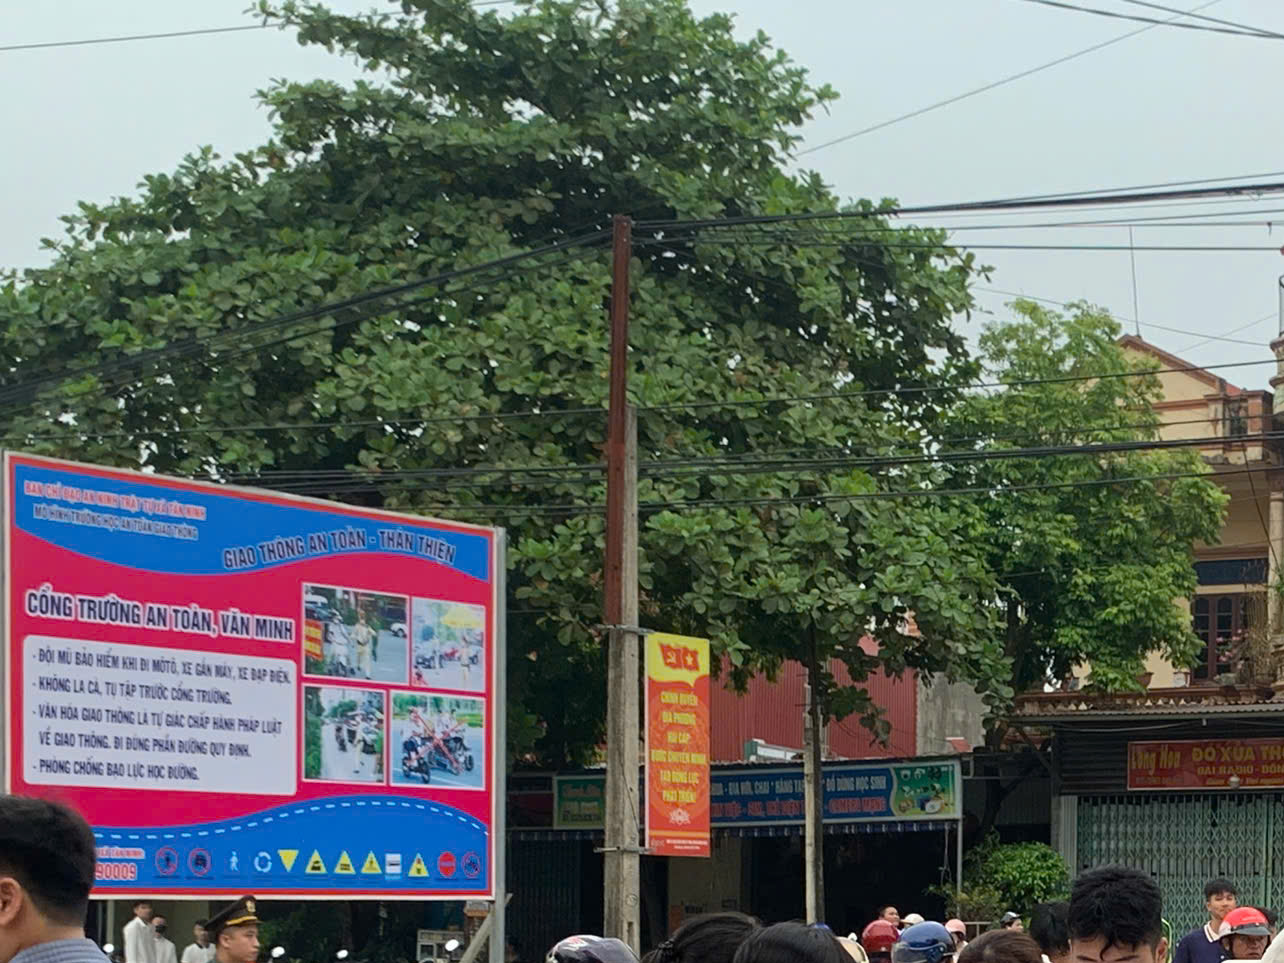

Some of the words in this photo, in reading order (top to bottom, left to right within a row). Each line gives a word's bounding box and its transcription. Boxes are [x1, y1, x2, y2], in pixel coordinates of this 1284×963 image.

[223, 546, 258, 569] GIAO
[258, 536, 305, 565] THÔNG
[307, 532, 328, 554] AN
[330, 525, 367, 550] TOÀN
[377, 526, 414, 552] THÂN
[416, 534, 457, 565] THIỆN
[26, 582, 74, 619] CỔNG
[76, 593, 142, 627] TRƯỜNG
[145, 603, 169, 630] AN
[171, 602, 218, 638] TOÀN,
[219, 607, 251, 638] VĂN
[253, 615, 296, 643] MINH
[39, 645, 55, 666] ĐỘI
[75, 647, 93, 666] BẢO
[122, 656, 138, 671] KHI
[140, 657, 150, 672] ĐI
[181, 661, 192, 676] XE
[238, 667, 248, 681] XE
[39, 674, 71, 693] KHÔNG
[73, 680, 85, 694] LA
[139, 681, 168, 700] TRƯỚC
[39, 702, 57, 719] VĂN
[81, 707, 102, 723] GIAO
[105, 706, 135, 725] THÔNG
[212, 713, 235, 732] HÀNH
[54, 732, 75, 747] GIAO
[178, 737, 208, 755] ĐƯỜNG
[210, 742, 226, 758] QUY
[39, 756, 71, 774] PHÒNG
[73, 755, 104, 776] CHỐNG
